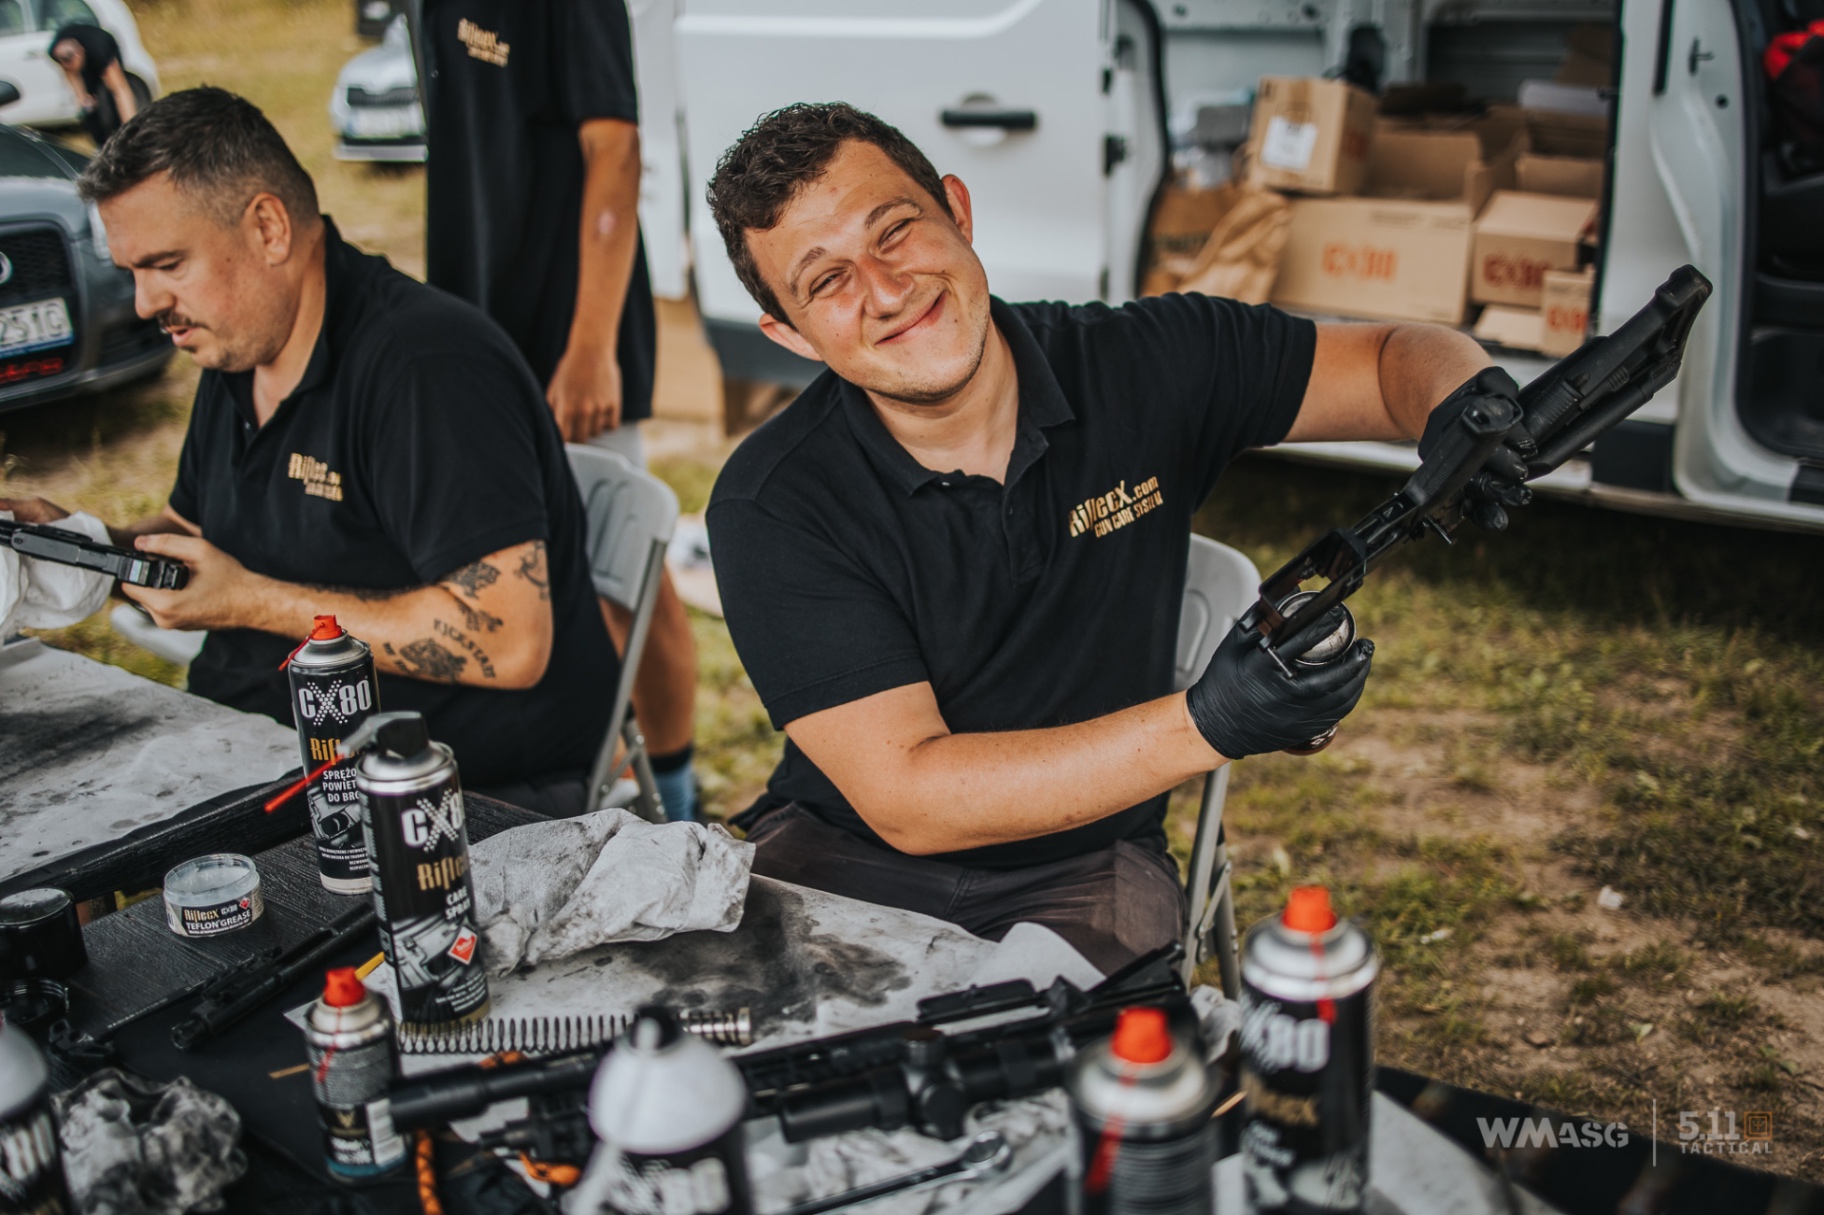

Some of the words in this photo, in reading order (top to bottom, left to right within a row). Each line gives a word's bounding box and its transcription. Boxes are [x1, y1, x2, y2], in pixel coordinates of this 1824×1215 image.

[1069, 476, 1159, 537] RiflecX.com
[1094, 518, 1113, 538] GUN
[1111, 506, 1135, 529] CARE
[1133, 490, 1163, 518] SYSTEM
[298, 680, 372, 726] CX80
[322, 780, 357, 792] POWIET
[323, 768, 357, 780] SPRĘŻO
[327, 792, 340, 802] DO
[401, 789, 463, 852] CX8
[417, 856, 468, 890] Rifle
[446, 886, 468, 906] CARE
[220, 910, 251, 927] GREASE
